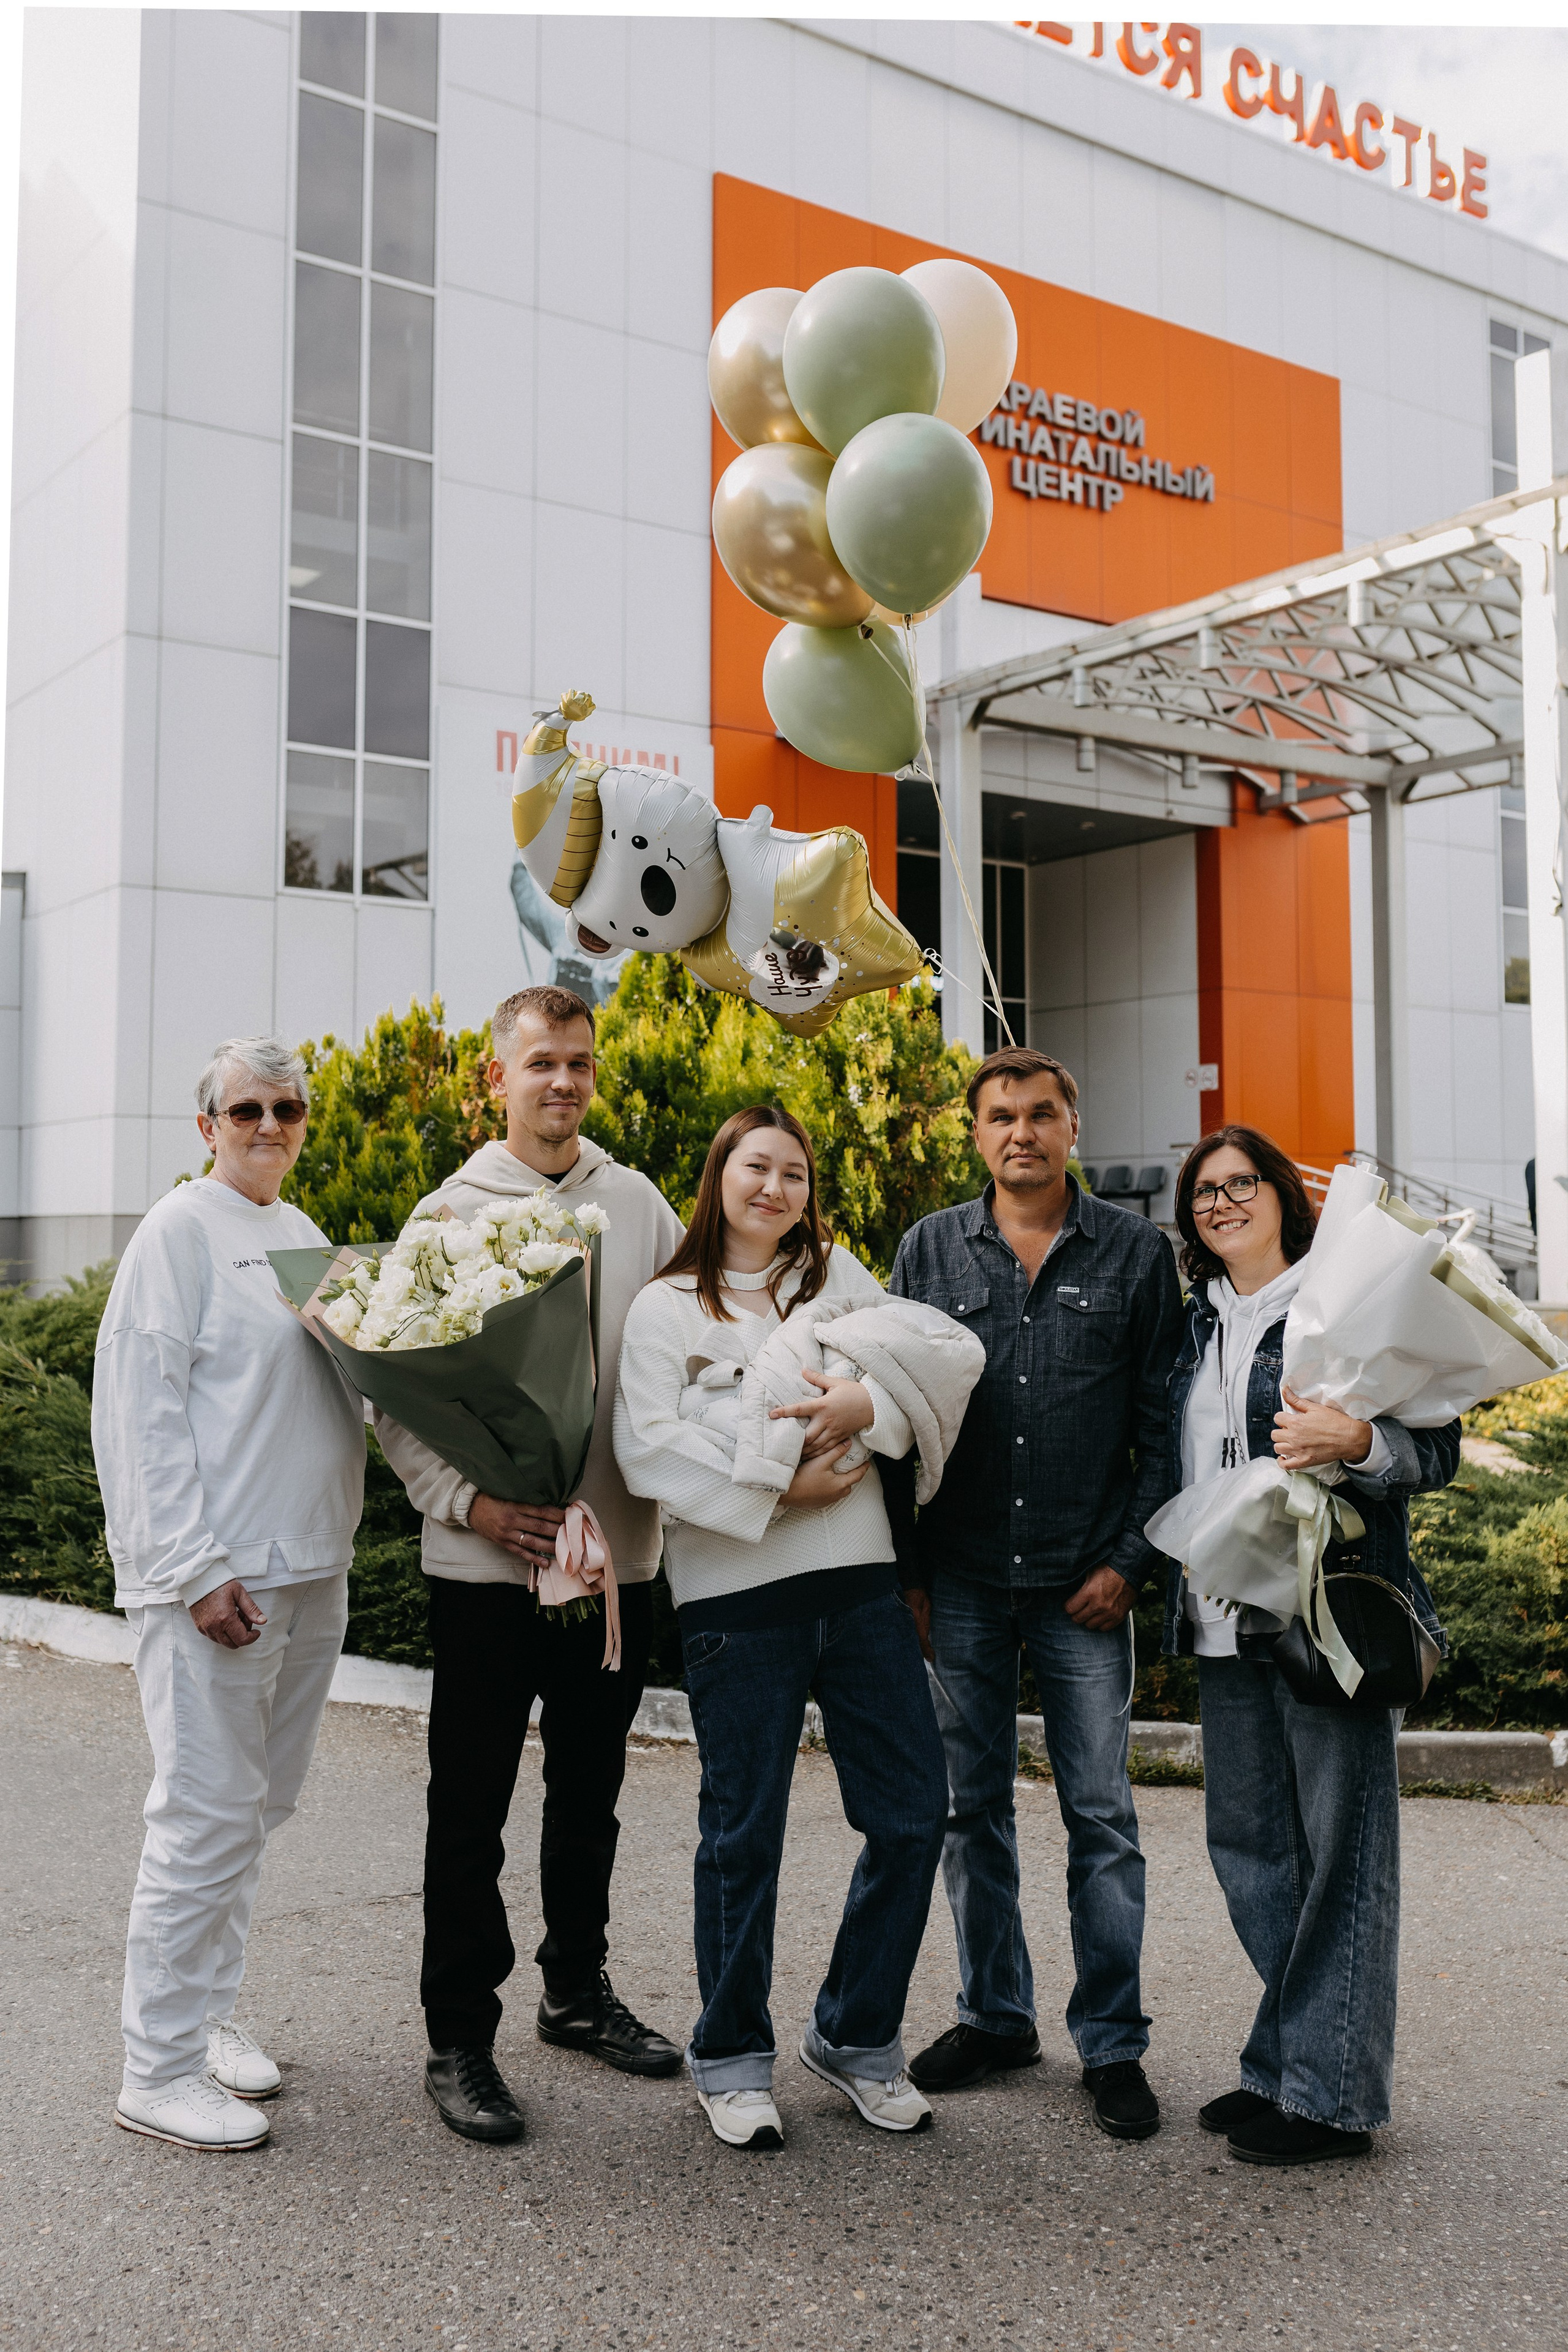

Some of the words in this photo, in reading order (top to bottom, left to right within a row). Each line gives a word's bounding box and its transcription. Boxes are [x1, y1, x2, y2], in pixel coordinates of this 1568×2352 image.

[1223, 47, 1488, 219] СЧАСТЬЕ
[1011, 455, 1125, 512] ЦЕНТР
[765, 952, 793, 996] Наше
[233, 1259, 250, 1268] CAN
